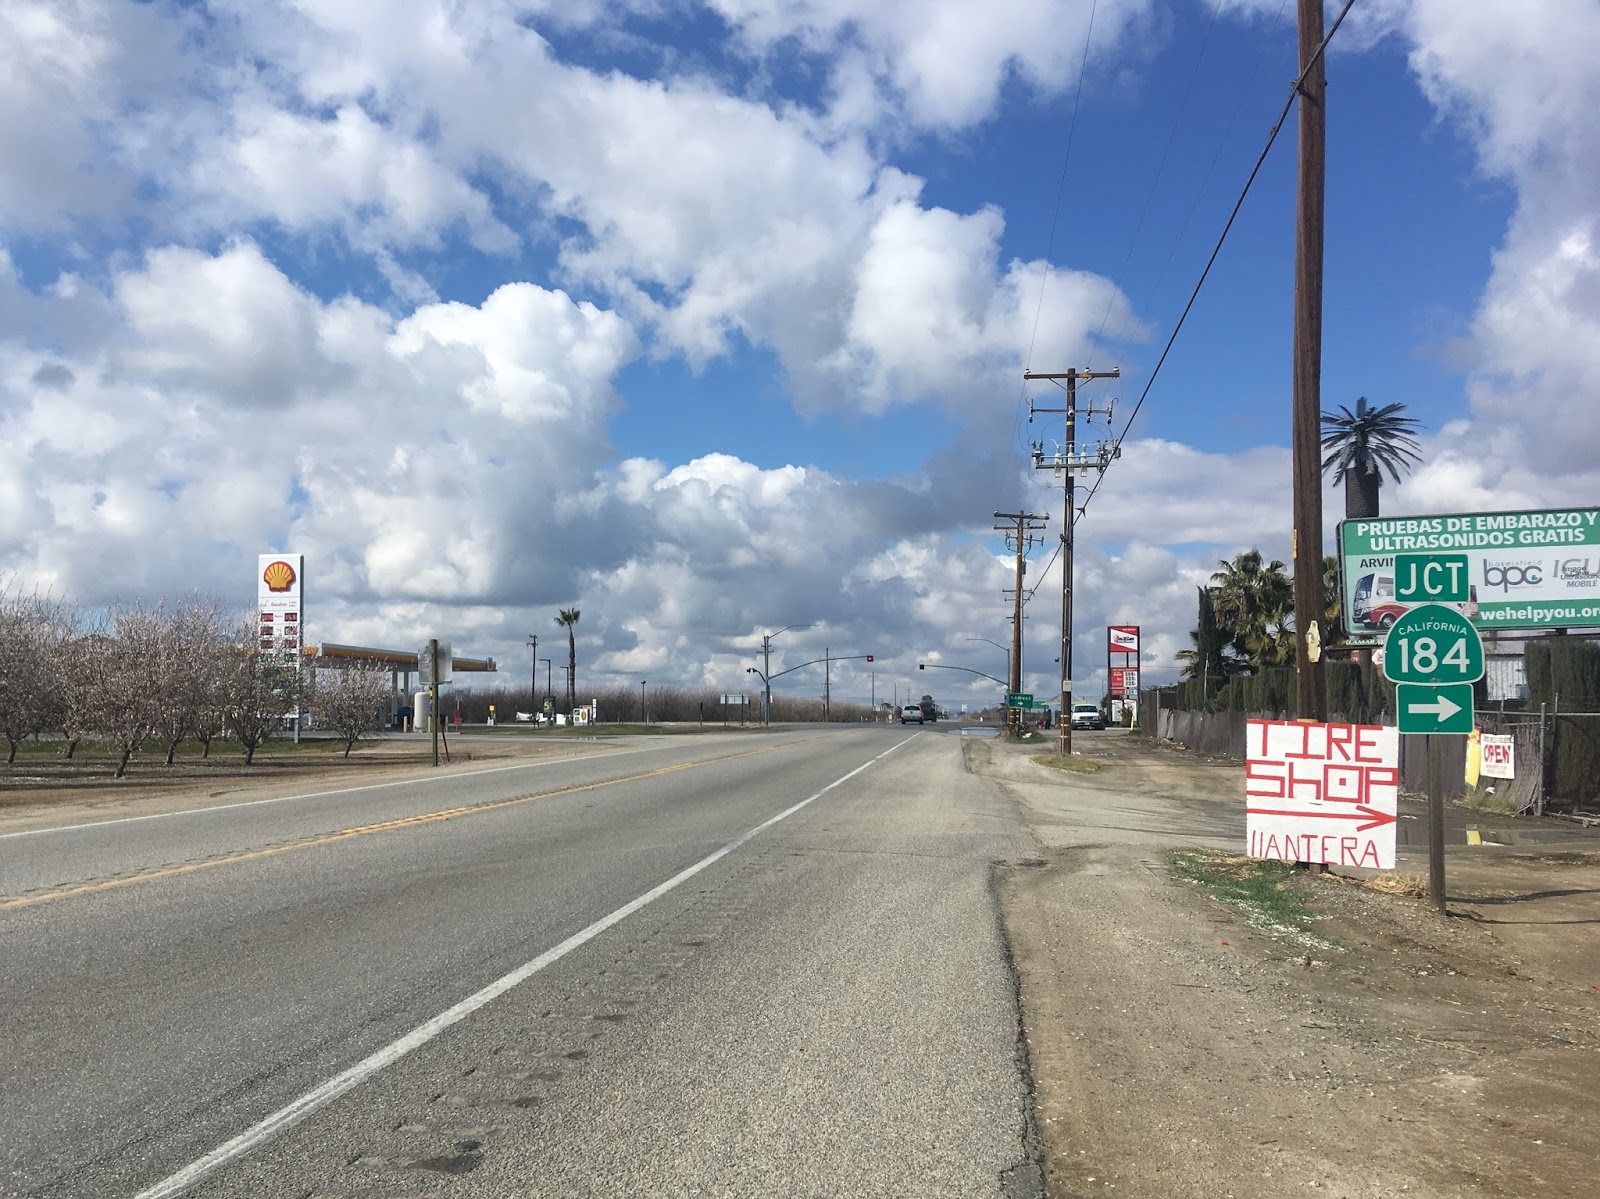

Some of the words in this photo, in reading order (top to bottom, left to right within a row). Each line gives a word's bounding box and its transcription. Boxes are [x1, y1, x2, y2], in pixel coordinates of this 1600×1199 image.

[1357, 519, 1443, 537] PRUEBAS
[1447, 517, 1472, 532] DE
[1476, 512, 1582, 531] EMBARAZO
[1584, 511, 1598, 526] Y
[1370, 530, 1515, 551] ULTRASONIDOS
[1518, 527, 1586, 544] GRATIS
[1399, 561, 1464, 595] JCT
[1483, 558, 1543, 593] bpc
[1566, 579, 1598, 588] MOBILE
[1480, 606, 1600, 622] wehelpyou.or
[1398, 621, 1468, 636] CALIFORNIA
[1398, 637, 1470, 674] 184
[1247, 719, 1383, 763] TIRE
[1483, 743, 1511, 764] OPEN
